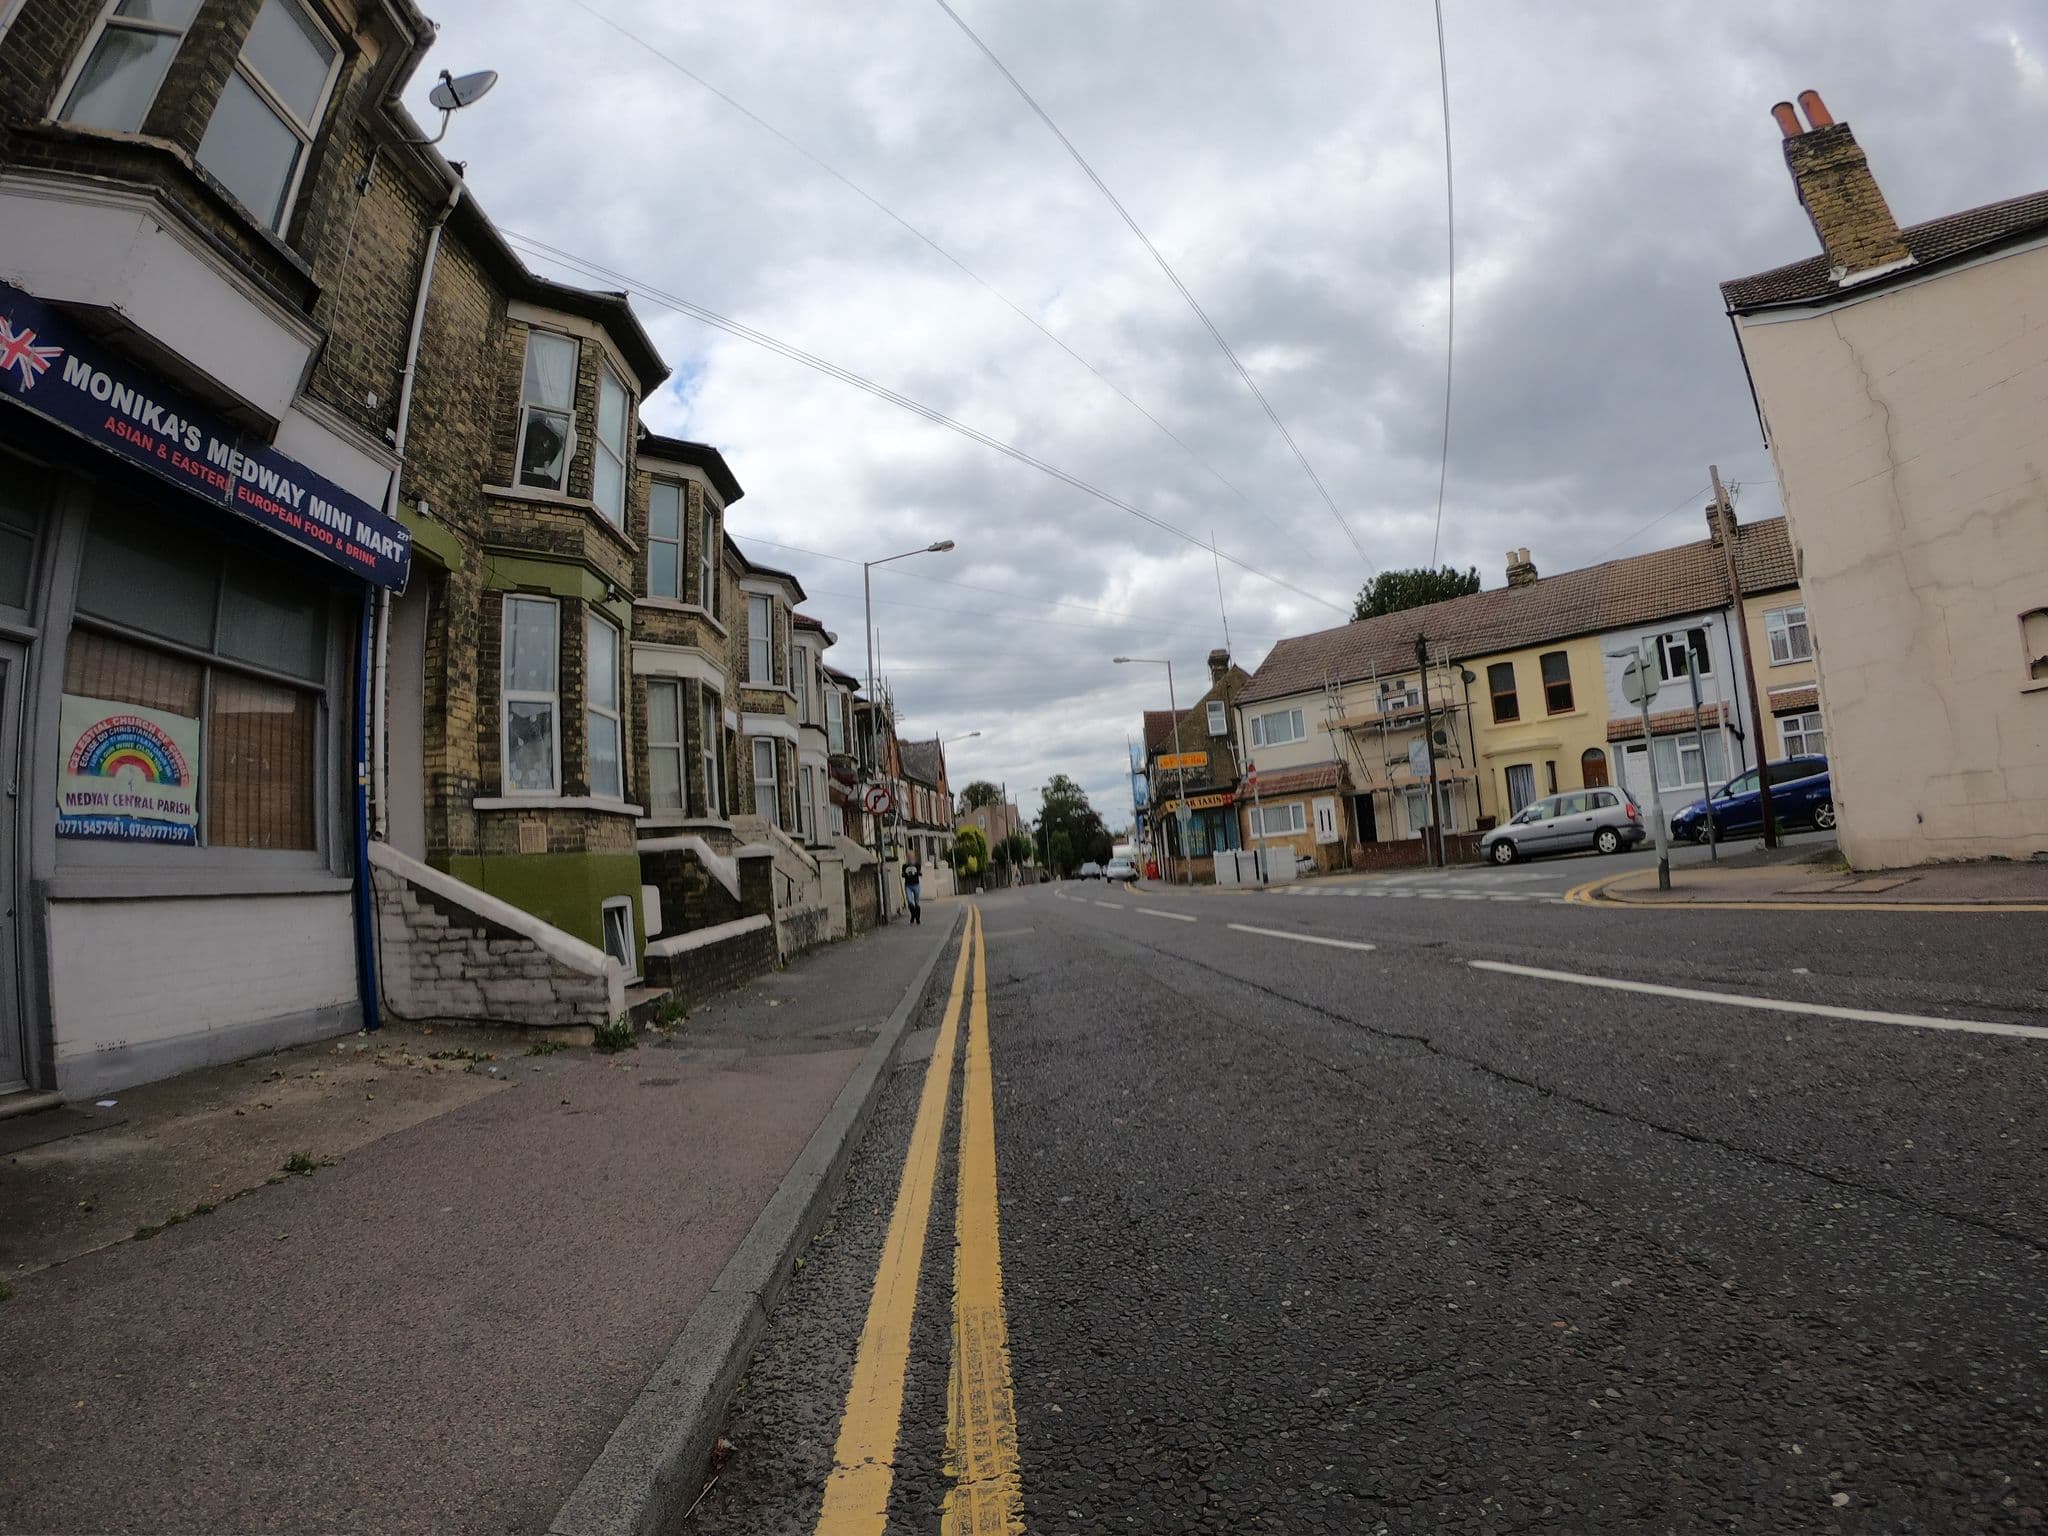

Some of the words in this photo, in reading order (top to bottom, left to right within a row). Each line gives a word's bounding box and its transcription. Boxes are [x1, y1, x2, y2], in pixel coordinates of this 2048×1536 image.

[62, 355, 202, 452] MONIKA'S
[207, 437, 304, 508] MEDWAY
[309, 494, 352, 535] MINI
[356, 520, 404, 562] MART
[104, 416, 153, 451] ASIAN
[157, 442, 167, 458] &
[237, 486, 301, 528] EUROPEAN
[304, 518, 334, 544] FOOD
[336, 538, 343, 551] &
[346, 544, 376, 568] DRINK
[69, 719, 112, 769] CELESTIAL
[112, 716, 156, 734] CHURCH
[158, 729, 171, 746] OF
[97, 732, 109, 742] DU
[157, 798, 191, 816] PARISH
